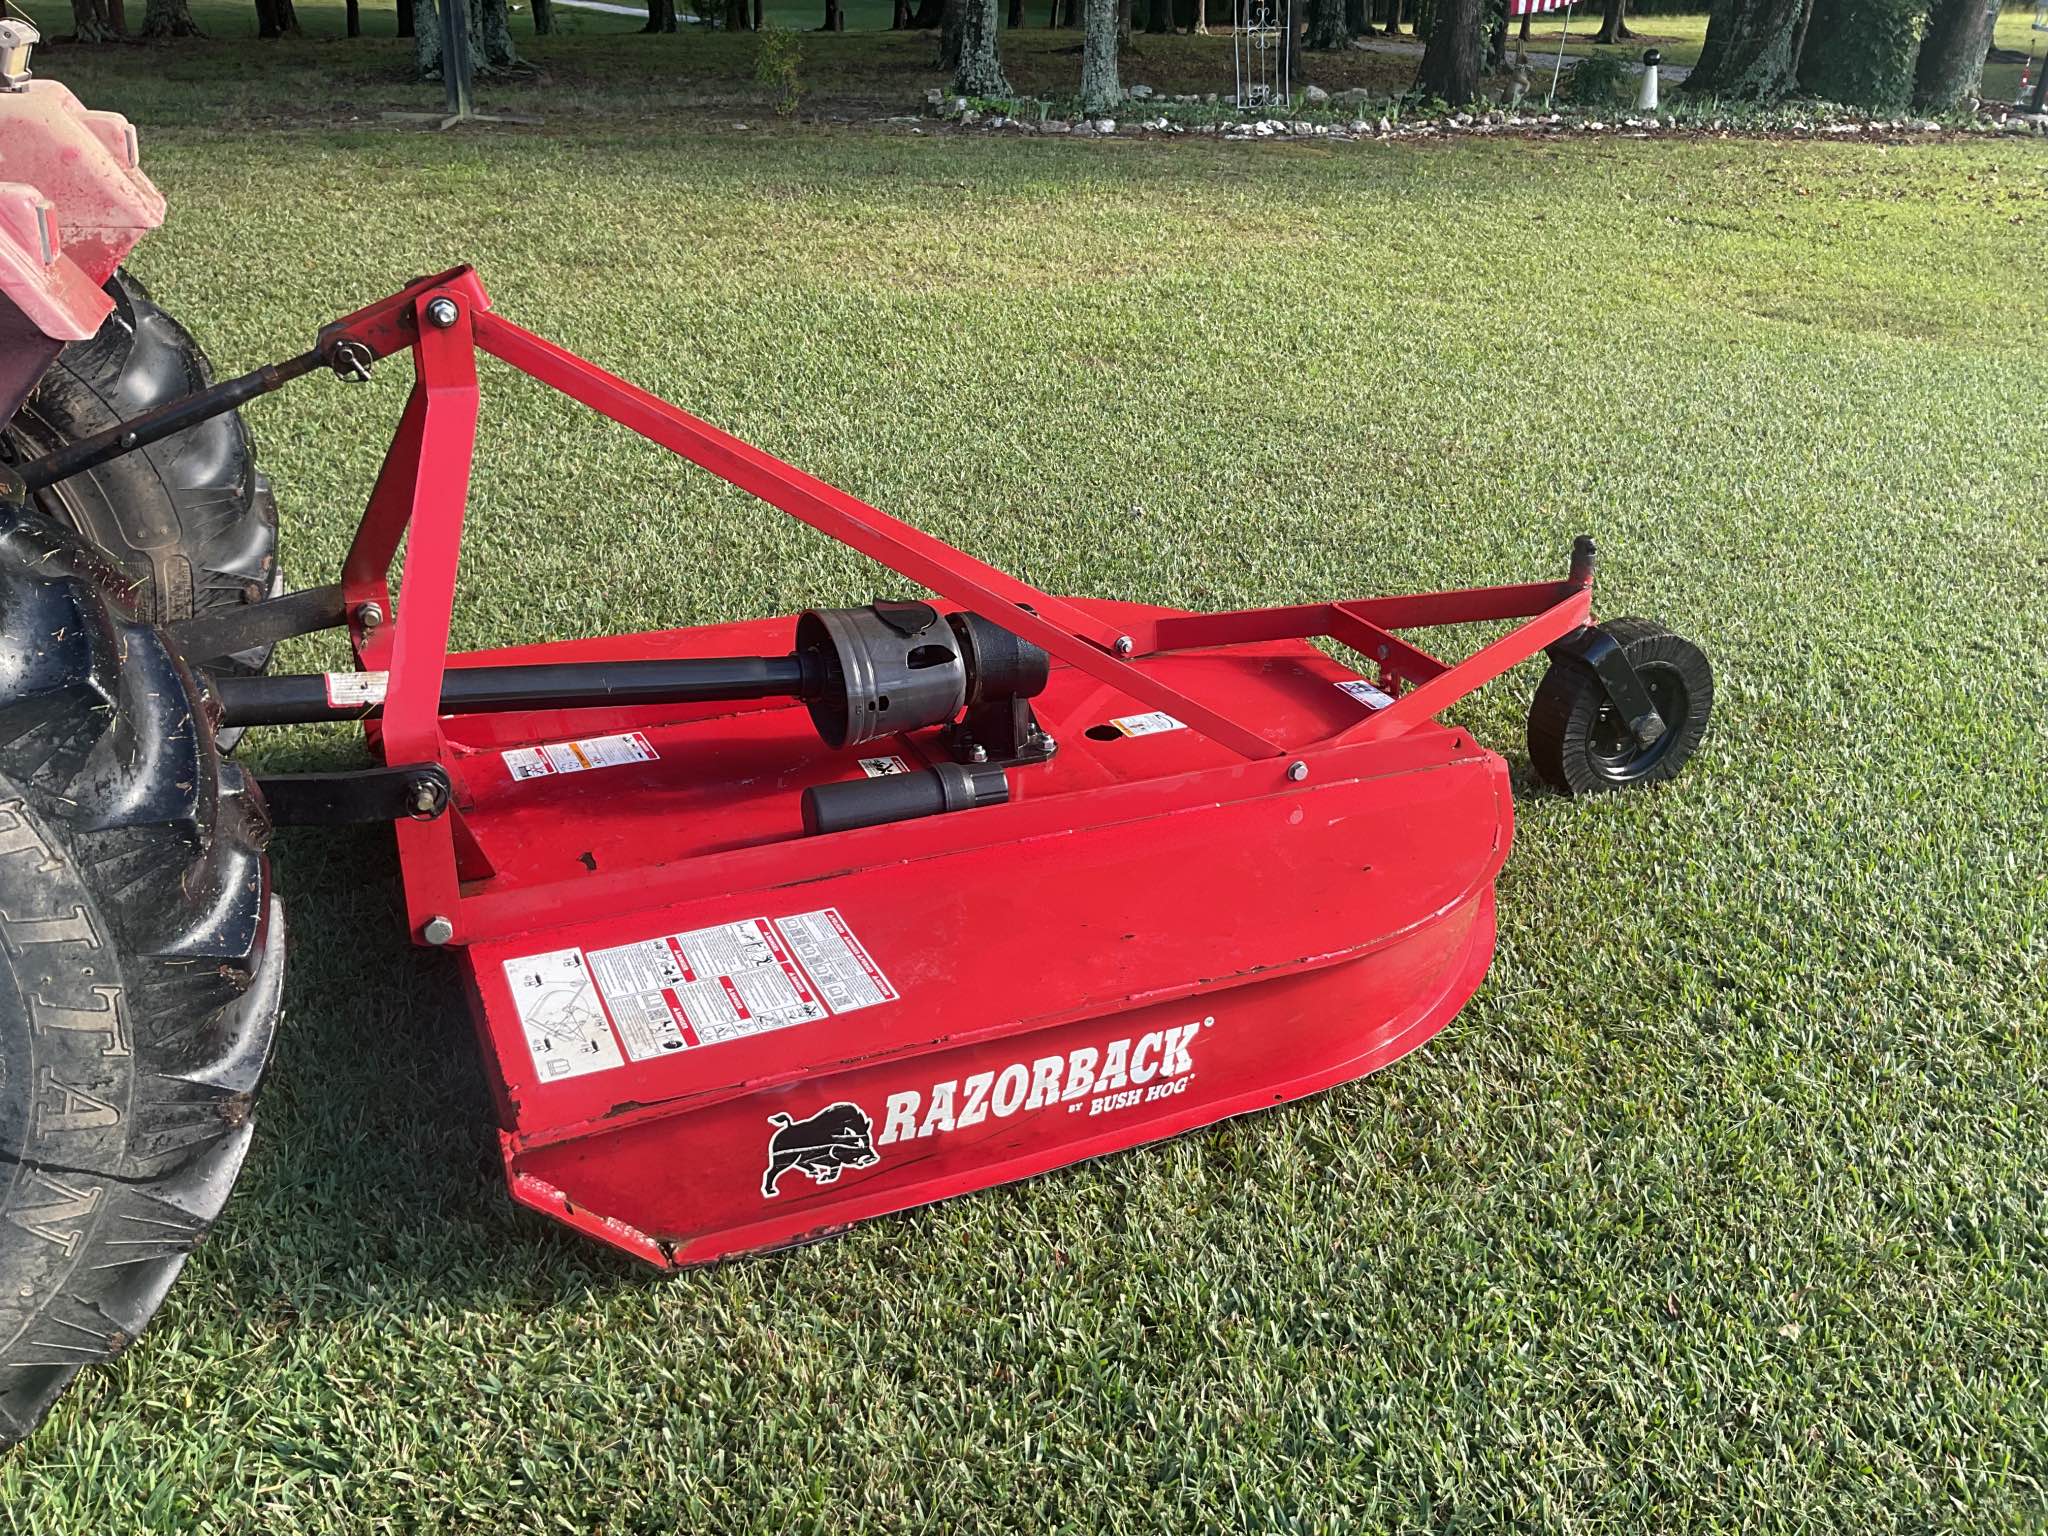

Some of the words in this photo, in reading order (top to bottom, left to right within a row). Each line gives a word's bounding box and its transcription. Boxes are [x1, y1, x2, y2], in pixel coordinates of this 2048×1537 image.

[878, 1023, 1200, 1146] RAZORBACK
[1067, 1102, 1083, 1113] BY
[1089, 1089, 1143, 1116] BUSH
[1145, 1077, 1189, 1102] HOG
